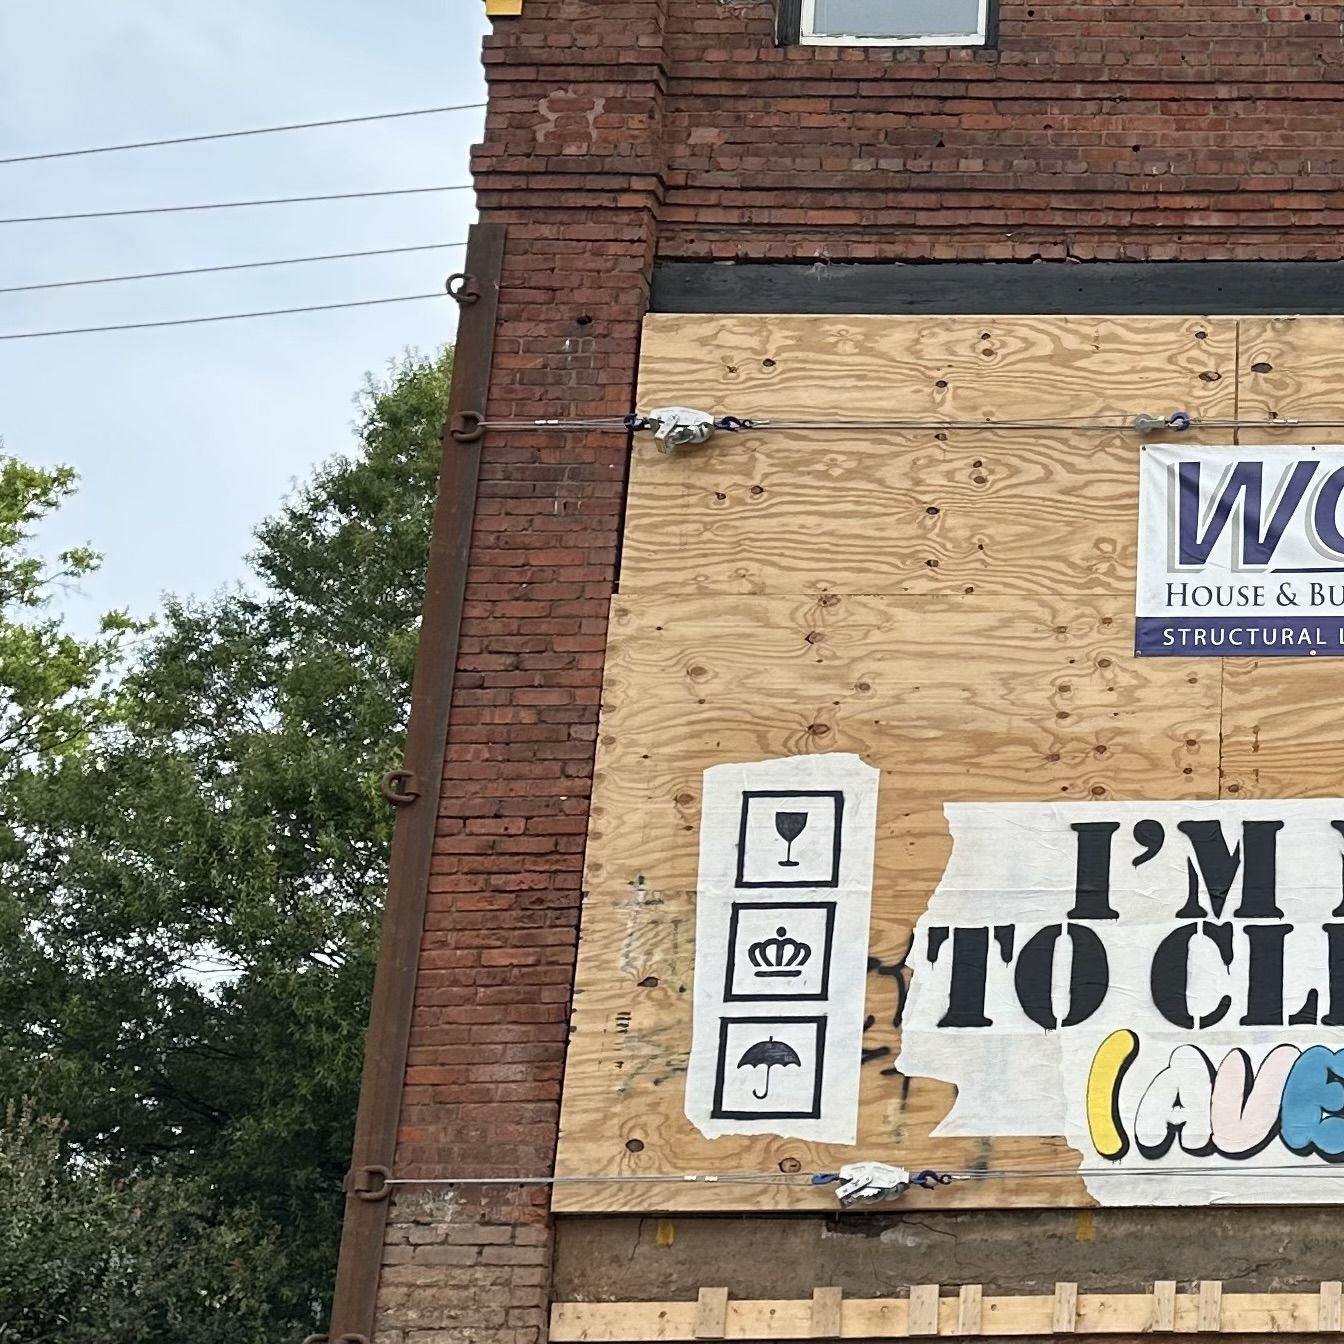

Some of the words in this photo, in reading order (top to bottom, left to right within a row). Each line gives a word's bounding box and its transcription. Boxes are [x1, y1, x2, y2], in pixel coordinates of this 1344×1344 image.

[1275, 582, 1298, 607] &
[1161, 626, 1328, 647] STRUCTURAL
[1066, 817, 1285, 920] I'M
[926, 921, 1111, 1031] TO
